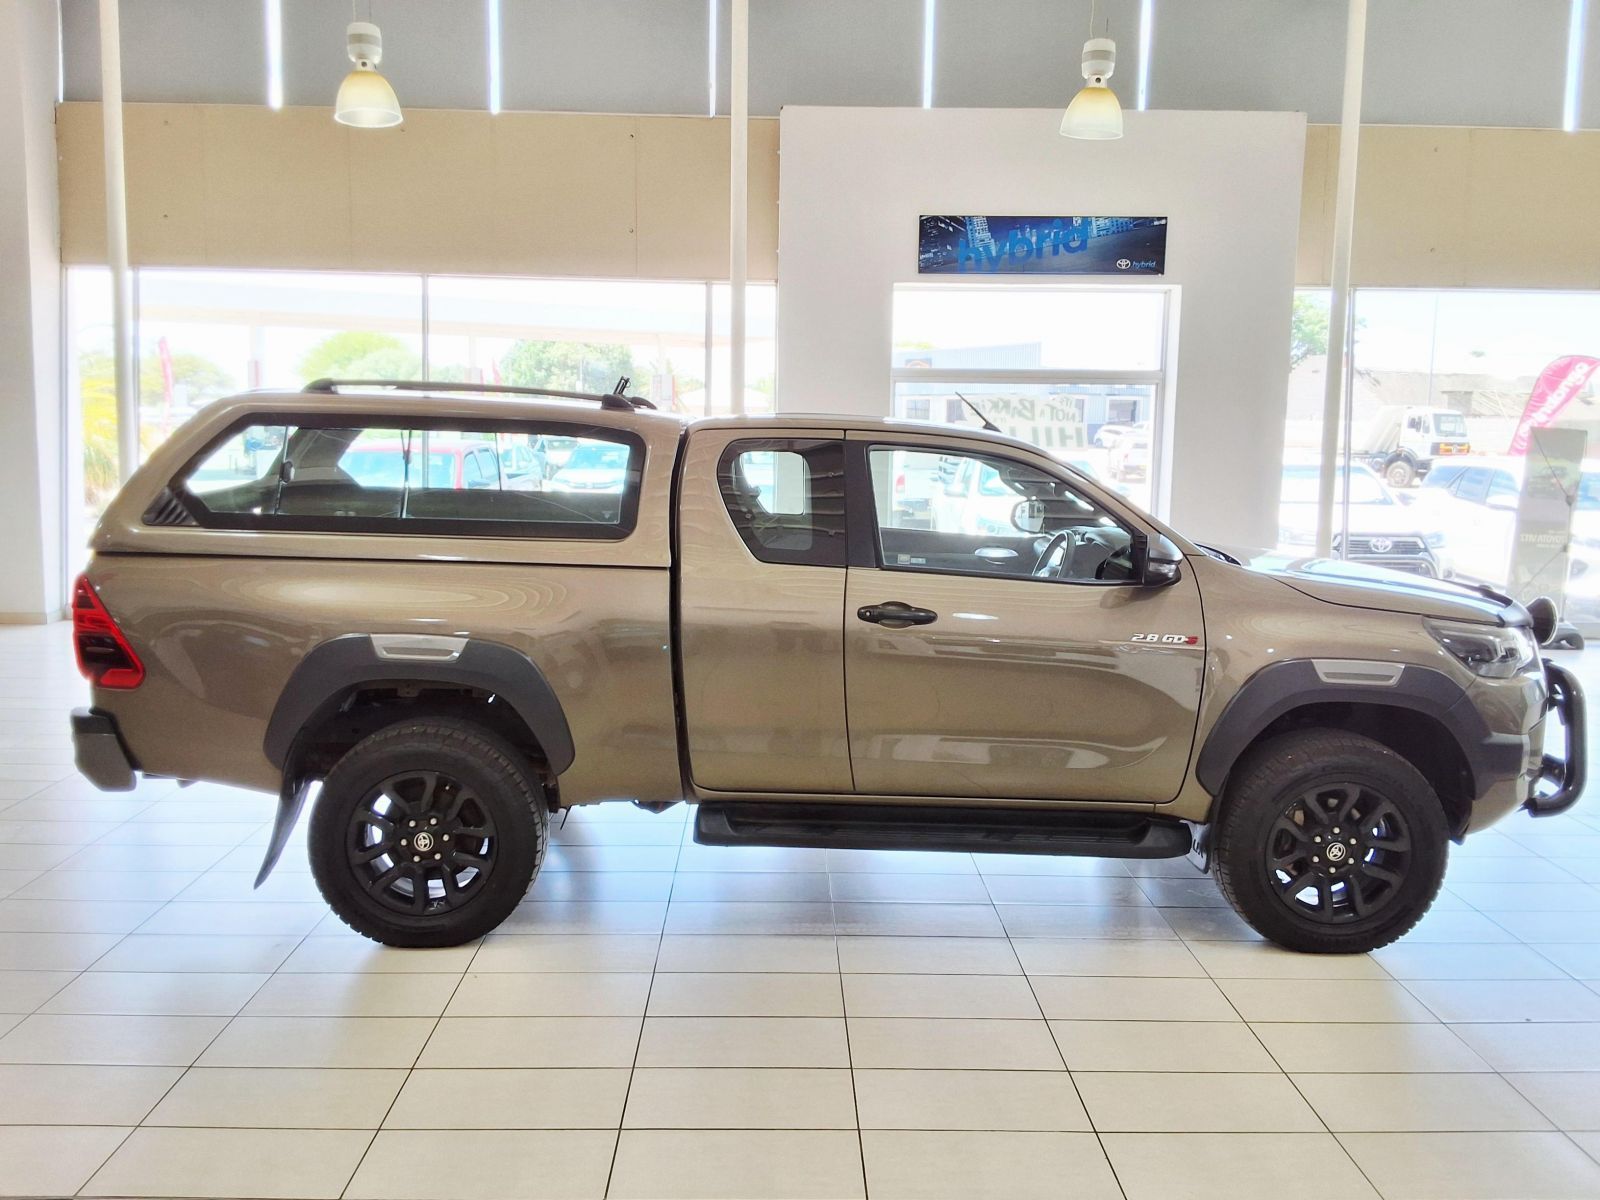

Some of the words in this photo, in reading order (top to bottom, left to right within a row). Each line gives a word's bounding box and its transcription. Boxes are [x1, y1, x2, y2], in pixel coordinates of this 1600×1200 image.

[959, 217, 1089, 272] hybrid
[1132, 260, 1156, 270] hybrid
[1131, 633, 1159, 642] 2.8
